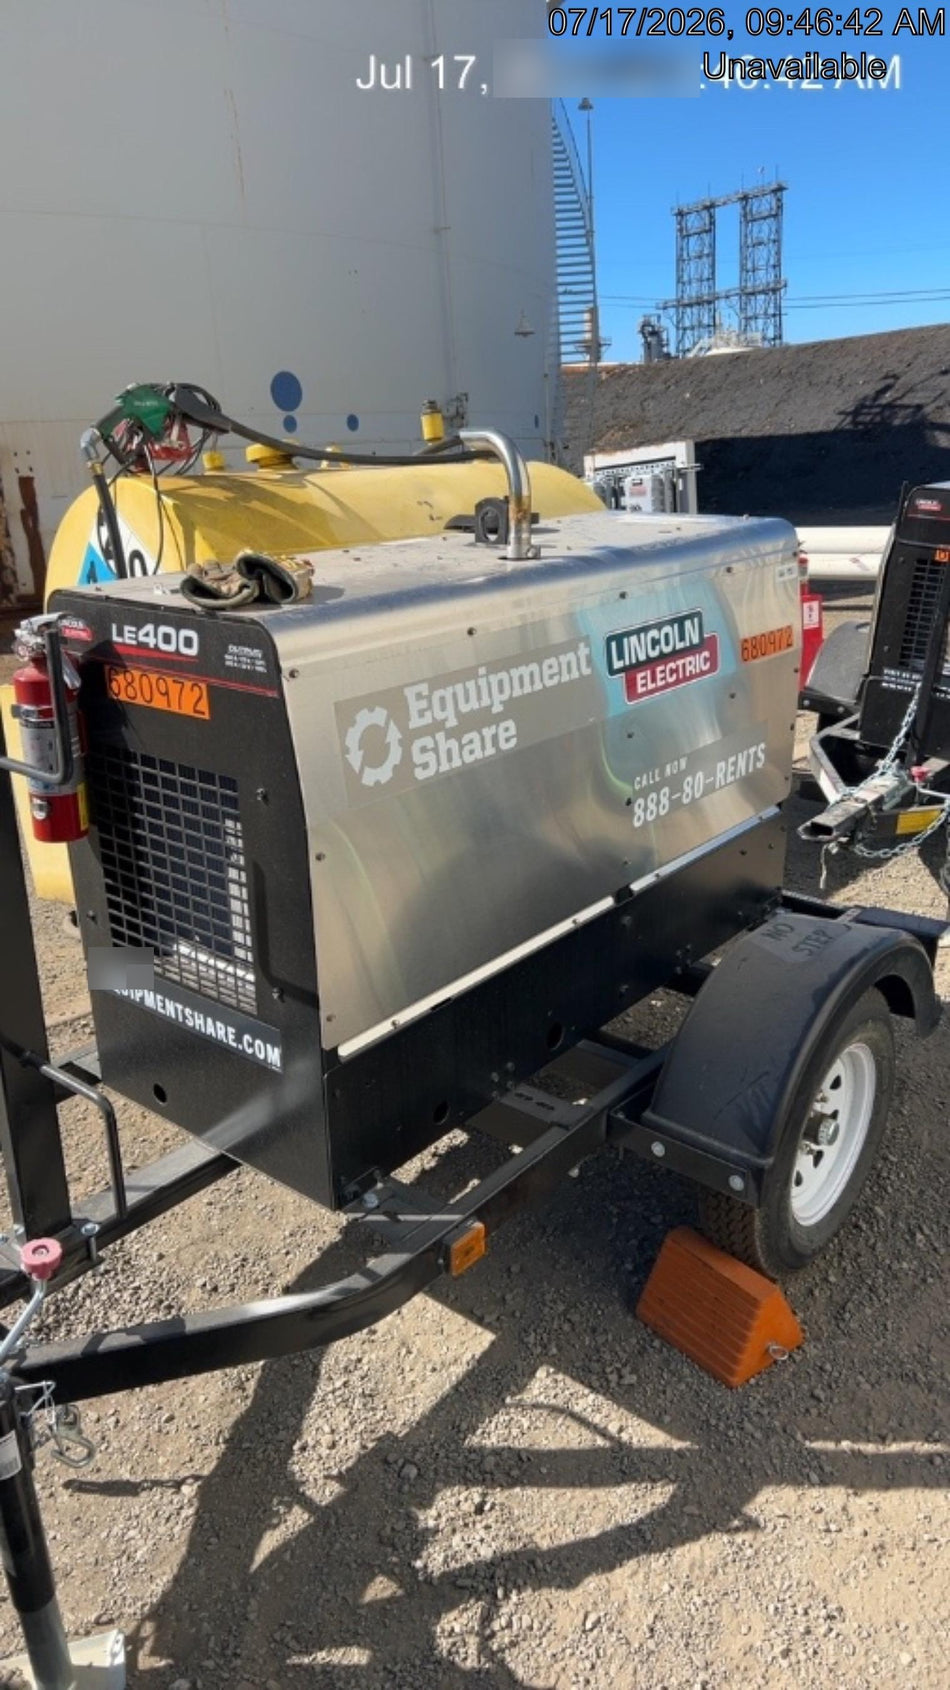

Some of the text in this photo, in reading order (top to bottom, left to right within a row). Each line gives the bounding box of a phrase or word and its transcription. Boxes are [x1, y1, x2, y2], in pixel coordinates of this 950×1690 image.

[112, 623, 199, 656] LE400
[611, 617, 701, 671] LINCOLN
[741, 625, 794, 662] 680972
[108, 666, 206, 716] 680972
[403, 642, 592, 730] Equipment
[636, 650, 711, 695] ELECTRIC
[411, 718, 518, 781] Share
[634, 756, 688, 791] CALL NOW
[632, 741, 767, 828] 888-80-RENTS
[762, 923, 794, 941] NO
[112, 988, 282, 1068] IPMENTSHARE.COM
